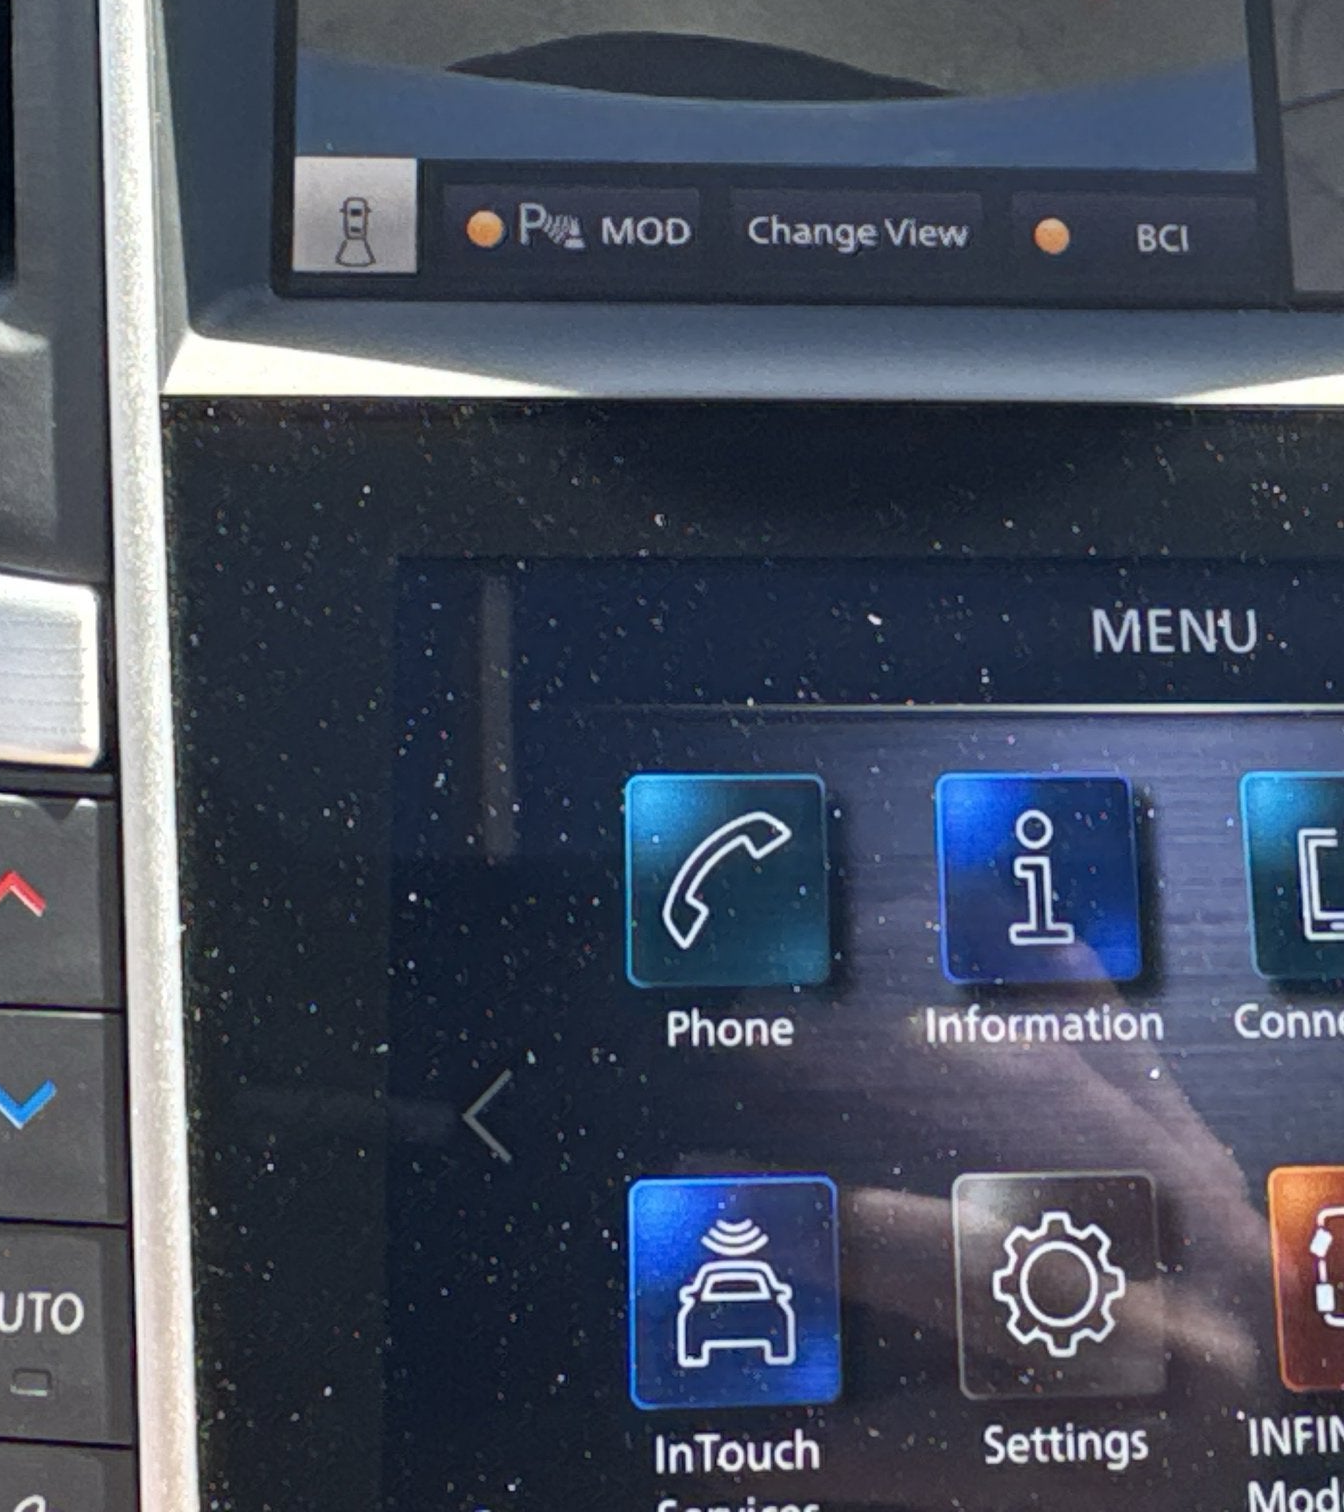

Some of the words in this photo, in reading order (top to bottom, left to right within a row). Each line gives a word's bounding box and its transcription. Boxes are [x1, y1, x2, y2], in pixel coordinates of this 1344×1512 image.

[601, 216, 692, 245] MOD
[747, 216, 878, 253] Change
[885, 218, 969, 249] View
[1136, 223, 1190, 253] BCI
[1091, 607, 1262, 654] MENU
[666, 1008, 795, 1047] Phone
[925, 1003, 1164, 1044] Information
[656, 1428, 820, 1474] InTouch
[984, 1424, 1149, 1471] Settings
